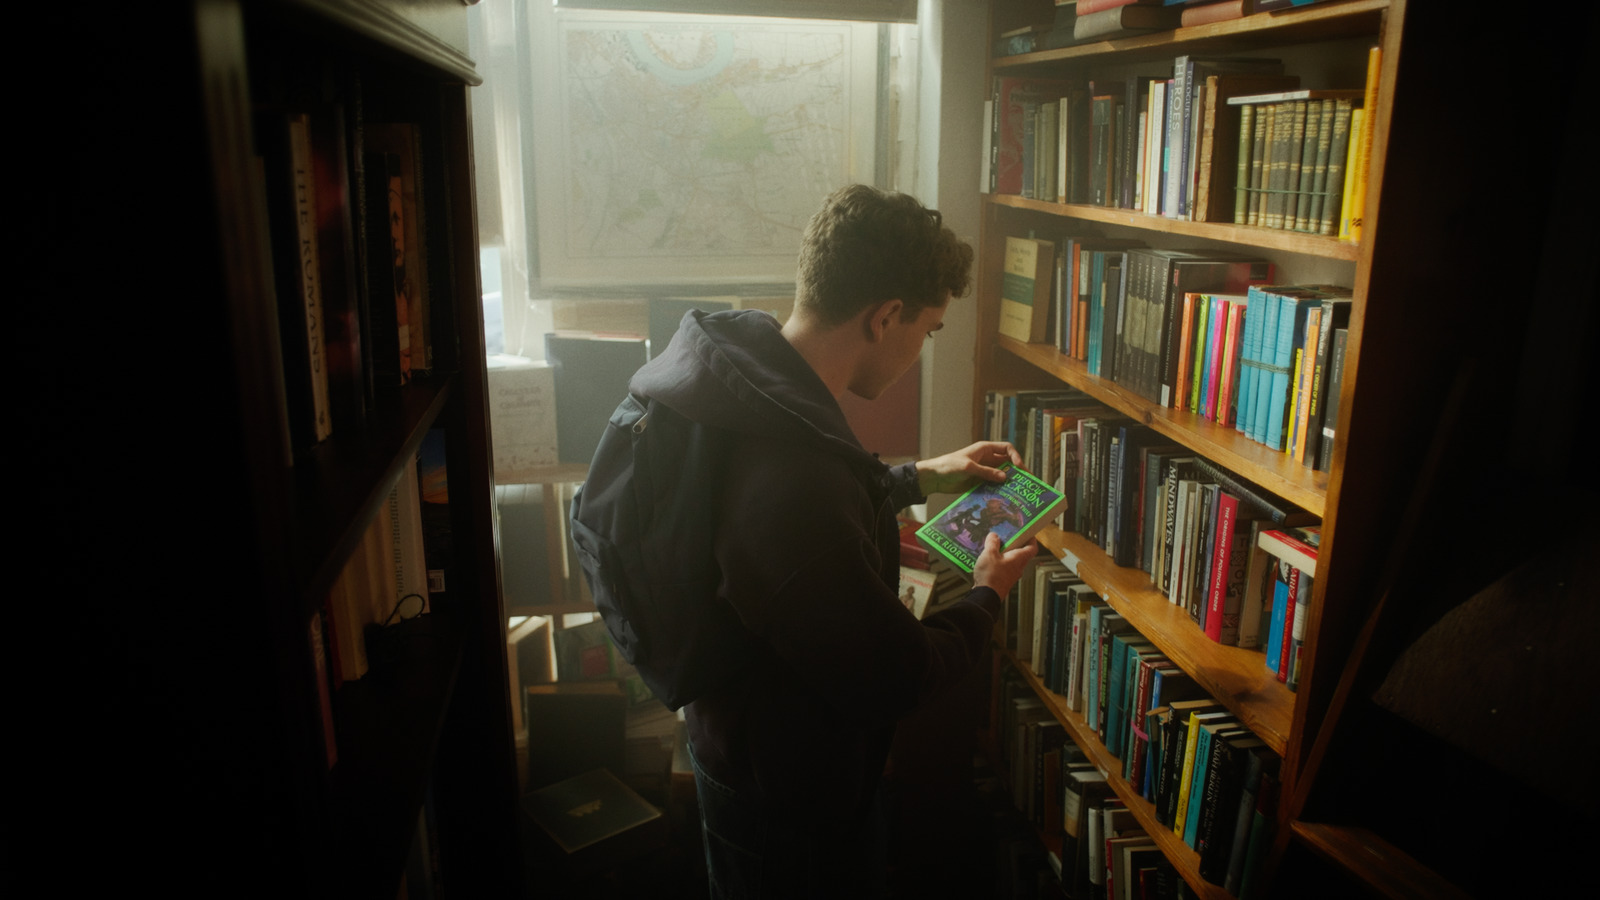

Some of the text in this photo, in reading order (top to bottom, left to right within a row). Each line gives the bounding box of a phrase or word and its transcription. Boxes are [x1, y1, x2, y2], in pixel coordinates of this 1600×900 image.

[1173, 63, 1184, 130] HEROES
[1184, 70, 1193, 118] ECLOGUES
[1300, 404, 1308, 426] WARS
[1012, 472, 1047, 495] PERCY
[1019, 504, 1032, 518] THIEF
[1165, 466, 1176, 546] MINDWAVES
[922, 527, 944, 545] RICK
[1220, 520, 1229, 548] ORIGINS
[1218, 549, 1225, 558] OF
[1214, 559, 1224, 589] POLITICAL
[1212, 590, 1220, 612] ORDER
[1206, 738, 1222, 801] ISAIAH BERLIN
